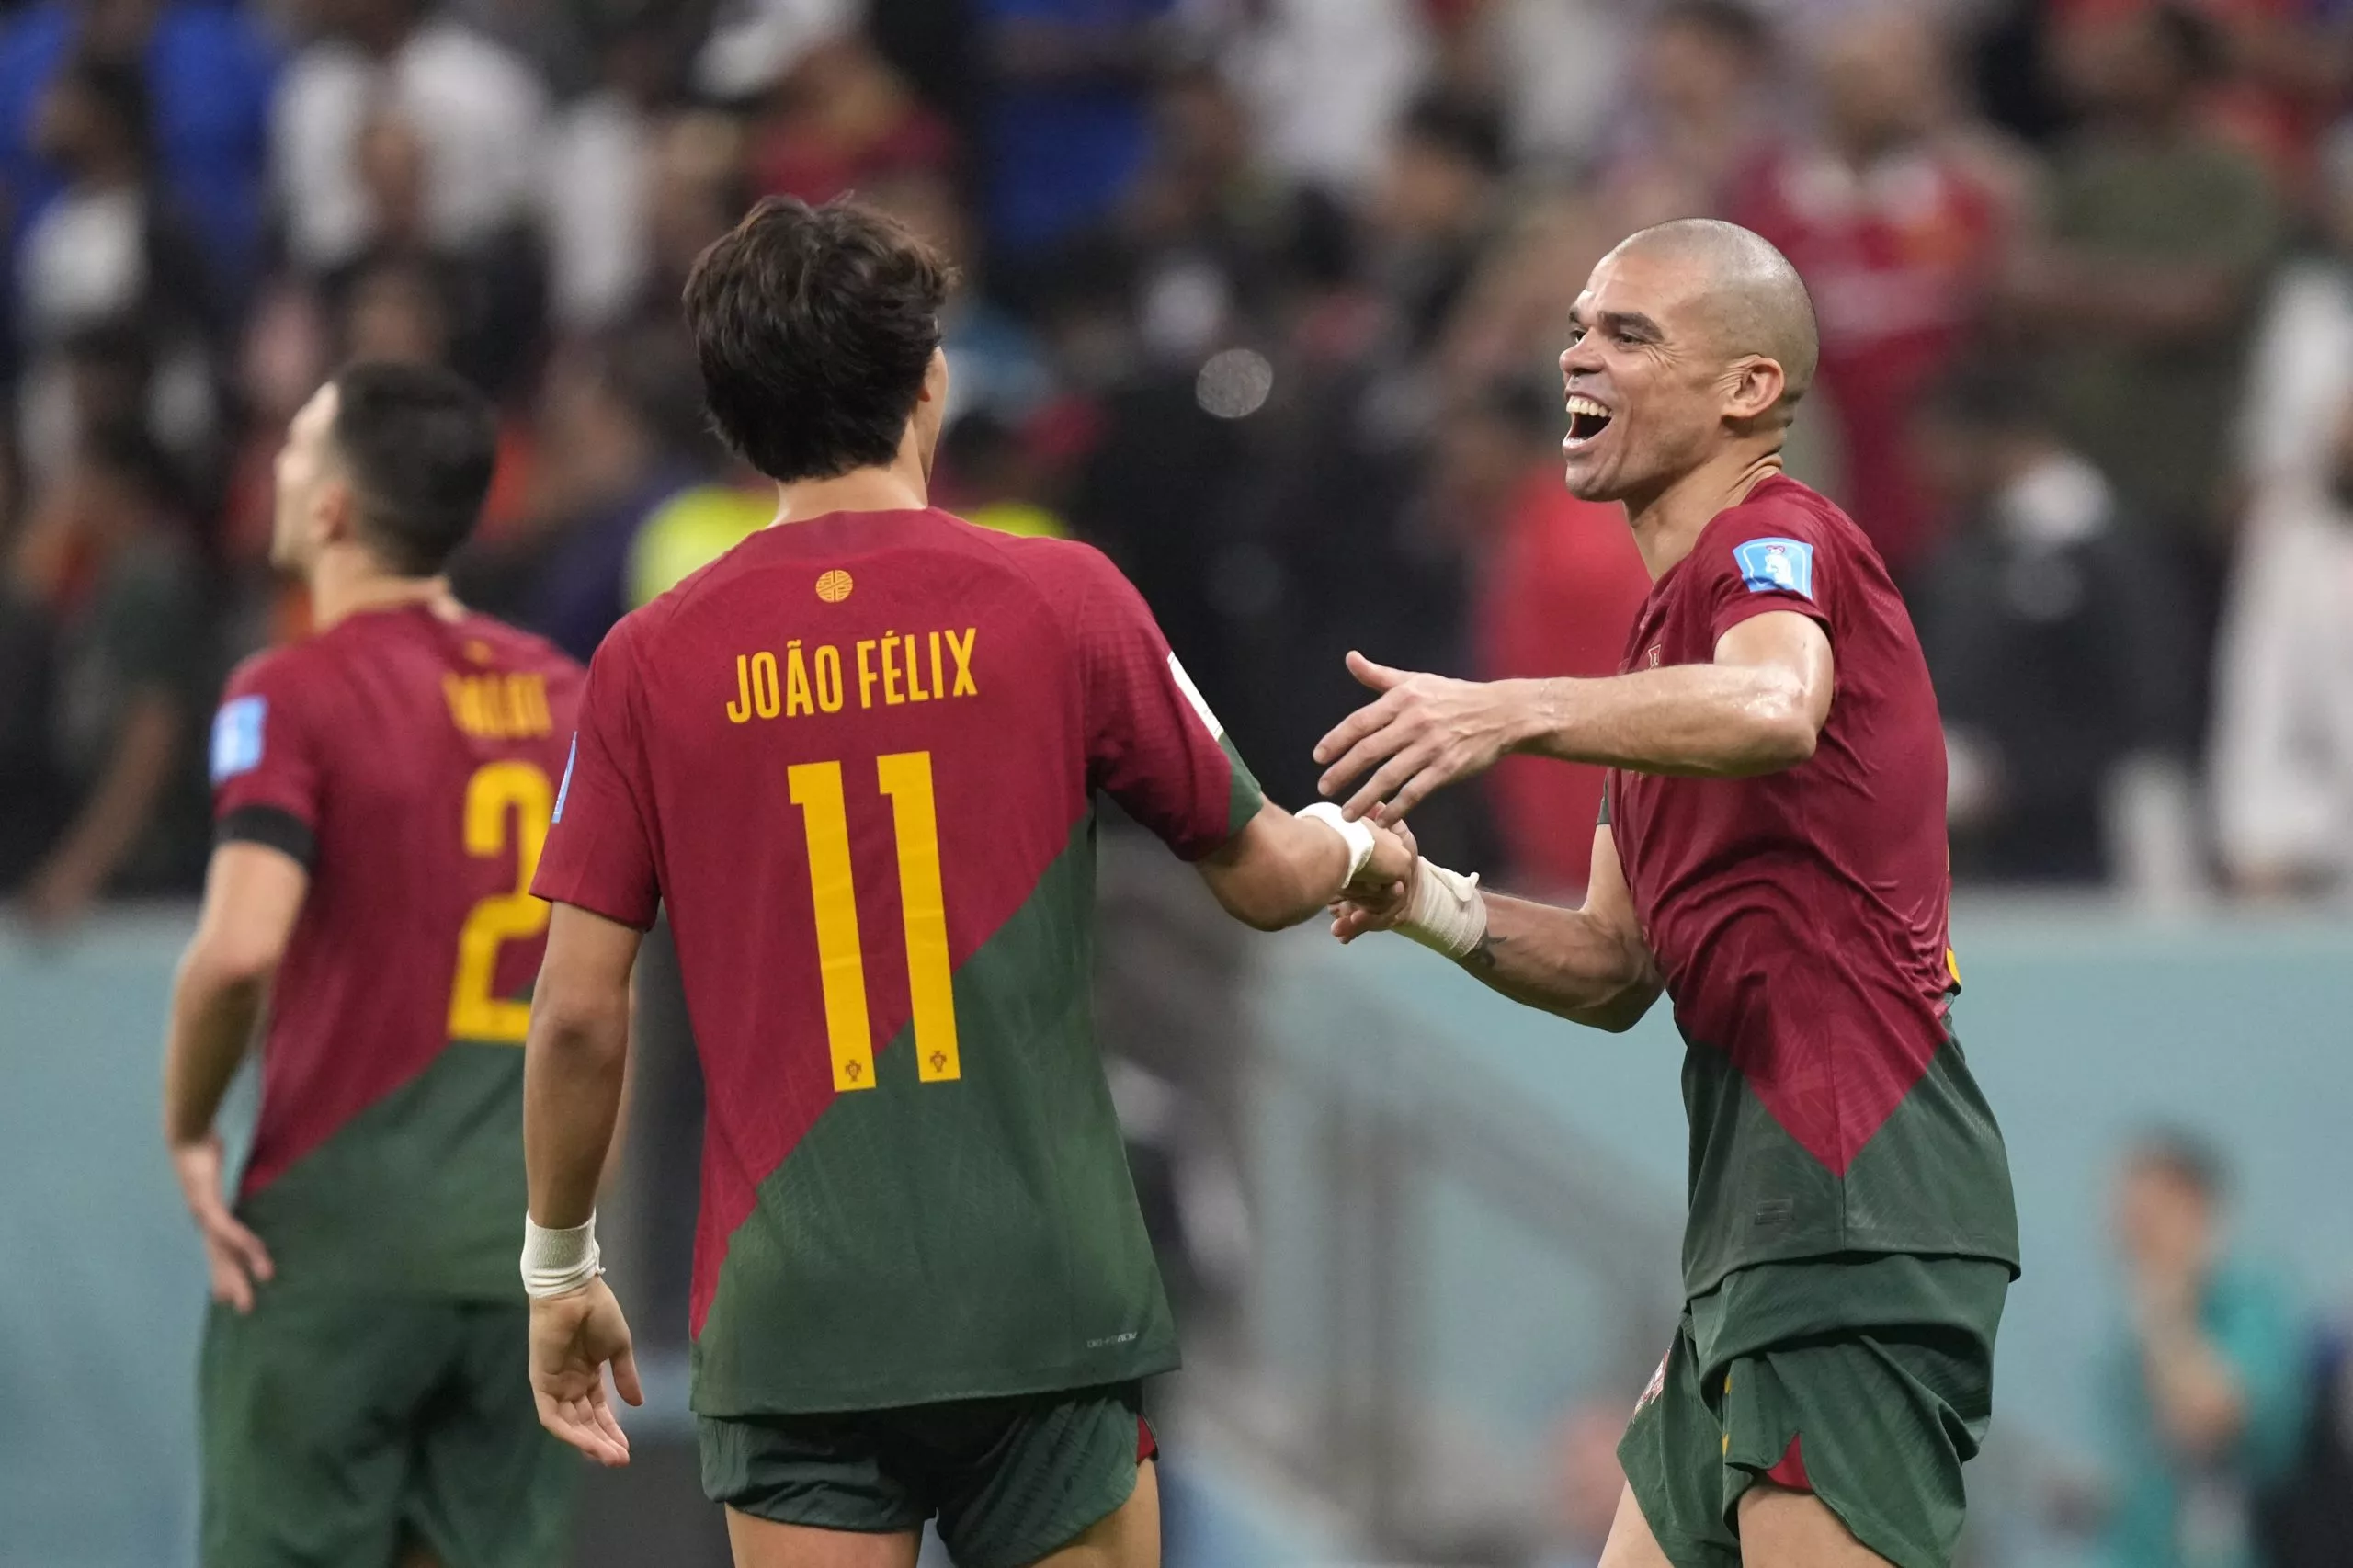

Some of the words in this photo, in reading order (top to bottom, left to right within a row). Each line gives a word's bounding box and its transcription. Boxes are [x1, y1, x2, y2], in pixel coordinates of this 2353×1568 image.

[726, 639, 844, 723] JOÃO
[856, 627, 978, 710] FÉLIX
[447, 760, 553, 1044] 2
[787, 750, 961, 1093] 11
